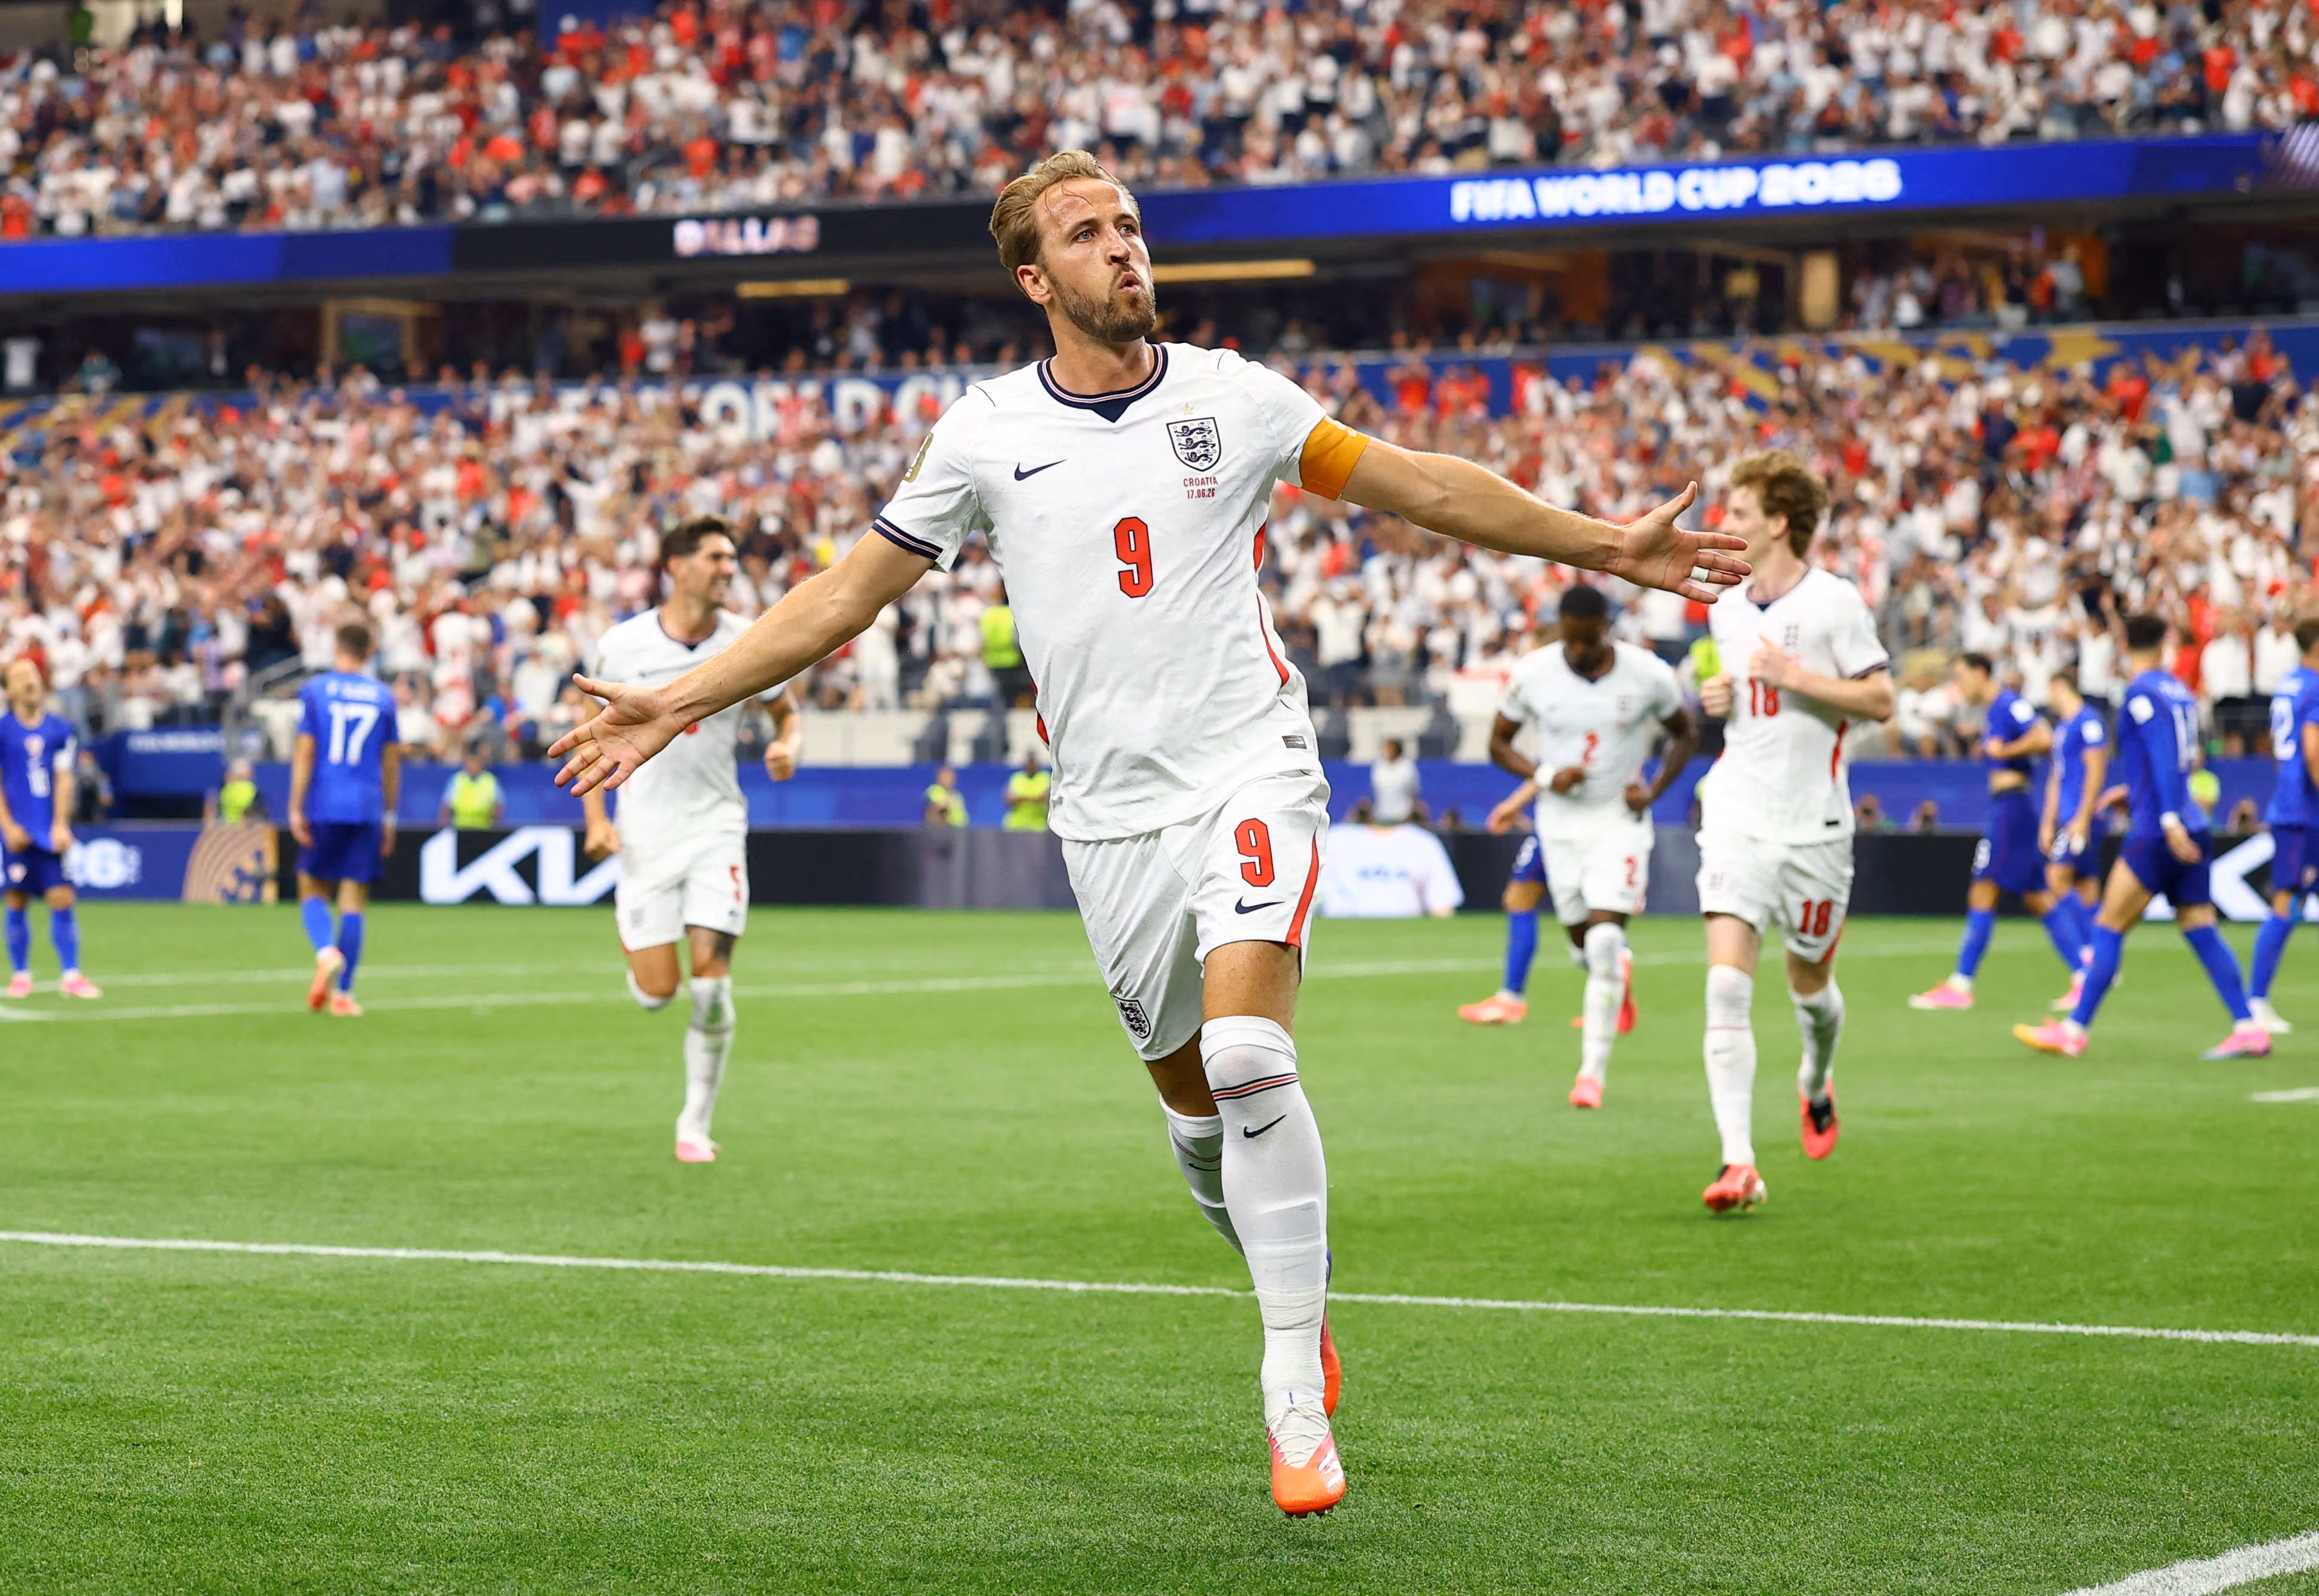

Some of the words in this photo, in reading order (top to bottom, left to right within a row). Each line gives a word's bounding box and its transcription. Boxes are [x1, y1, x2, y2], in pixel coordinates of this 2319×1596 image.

[1450, 178, 1536, 222] FIFA
[1535, 171, 1676, 216] WORLD
[1677, 166, 1758, 211] CUP
[1758, 158, 1902, 207] 2026
[1183, 477, 1218, 487] CROATIA
[1187, 488, 1215, 499] 17.06.26
[1114, 516, 1154, 598] 9
[329, 701, 380, 765] 17
[1583, 729, 1599, 766] 2
[1234, 818, 1275, 887] 9
[1623, 856, 1639, 887] 2
[1800, 900, 1832, 937] 18
